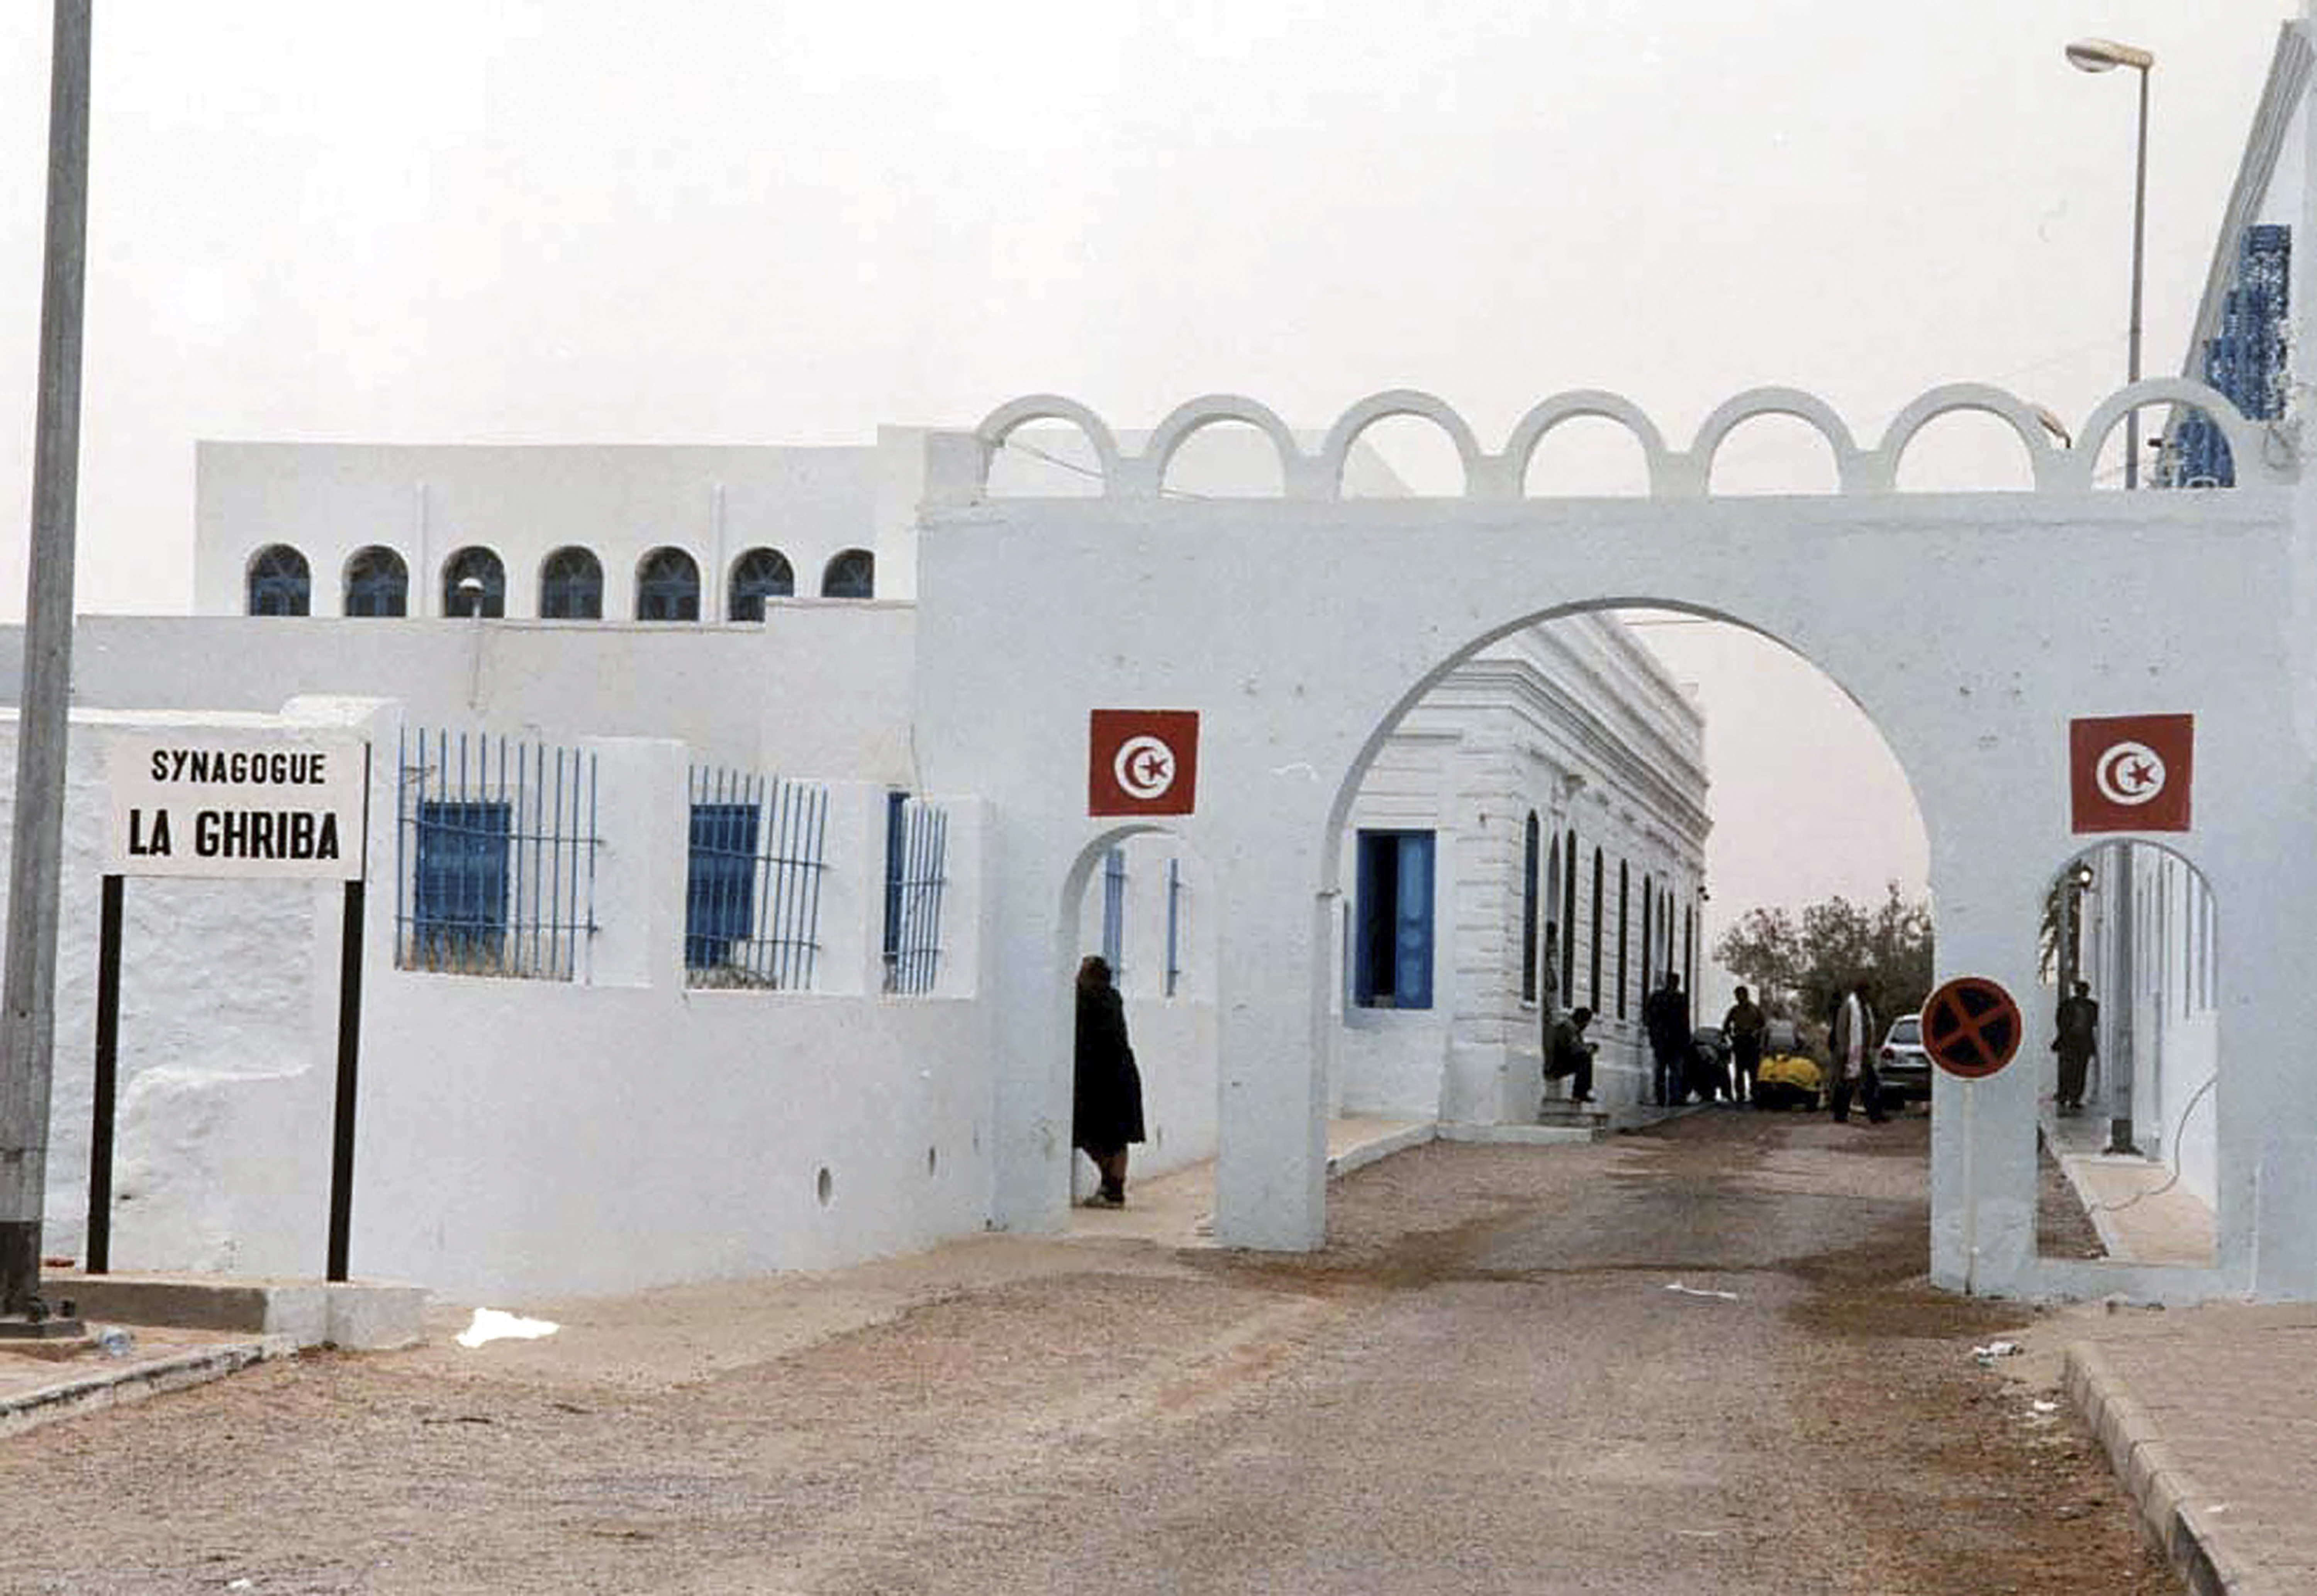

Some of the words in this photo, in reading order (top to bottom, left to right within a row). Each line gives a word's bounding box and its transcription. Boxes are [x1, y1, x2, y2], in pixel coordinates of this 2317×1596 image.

[151, 750, 326, 784] SYNAGOGUE
[129, 809, 171, 856] LA
[195, 810, 339, 860] GHRIBA
